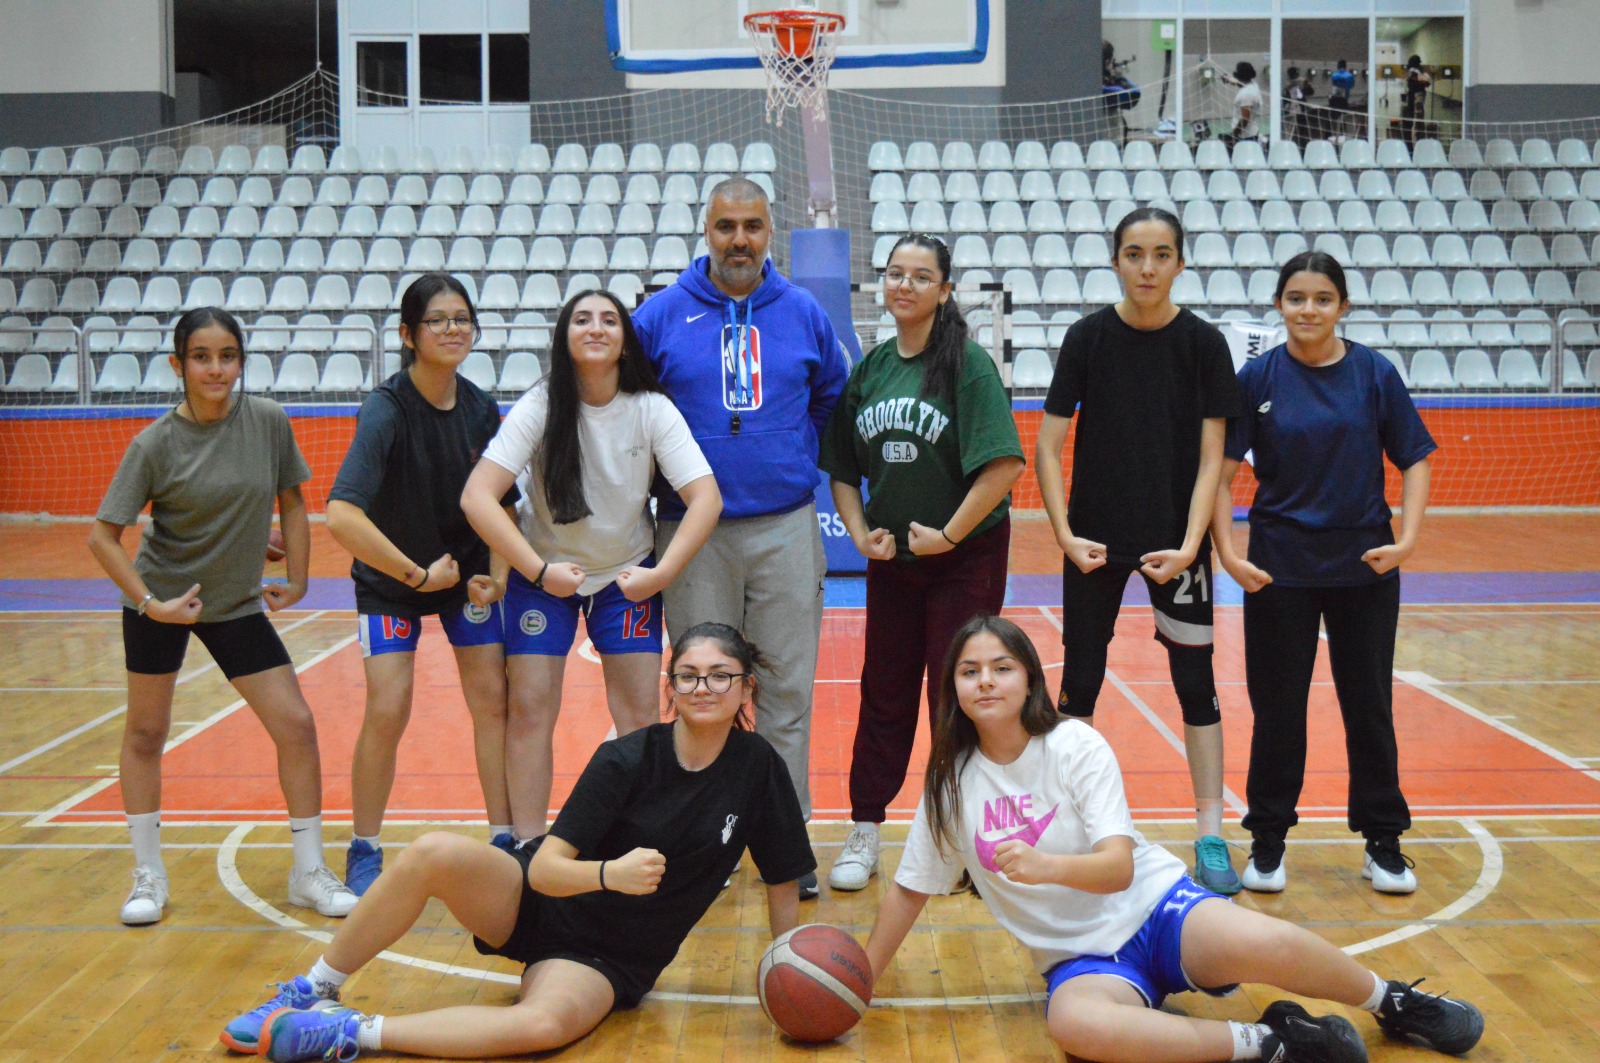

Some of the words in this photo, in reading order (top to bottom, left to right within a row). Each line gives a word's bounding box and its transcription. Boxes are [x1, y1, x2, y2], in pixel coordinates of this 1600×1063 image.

[729, 390, 748, 405] NA
[855, 397, 950, 445] BROOKLYN
[816, 512, 851, 537] RS
[1172, 563, 1208, 605] 21
[622, 600, 650, 639] 12
[983, 793, 1035, 833] NIKE
